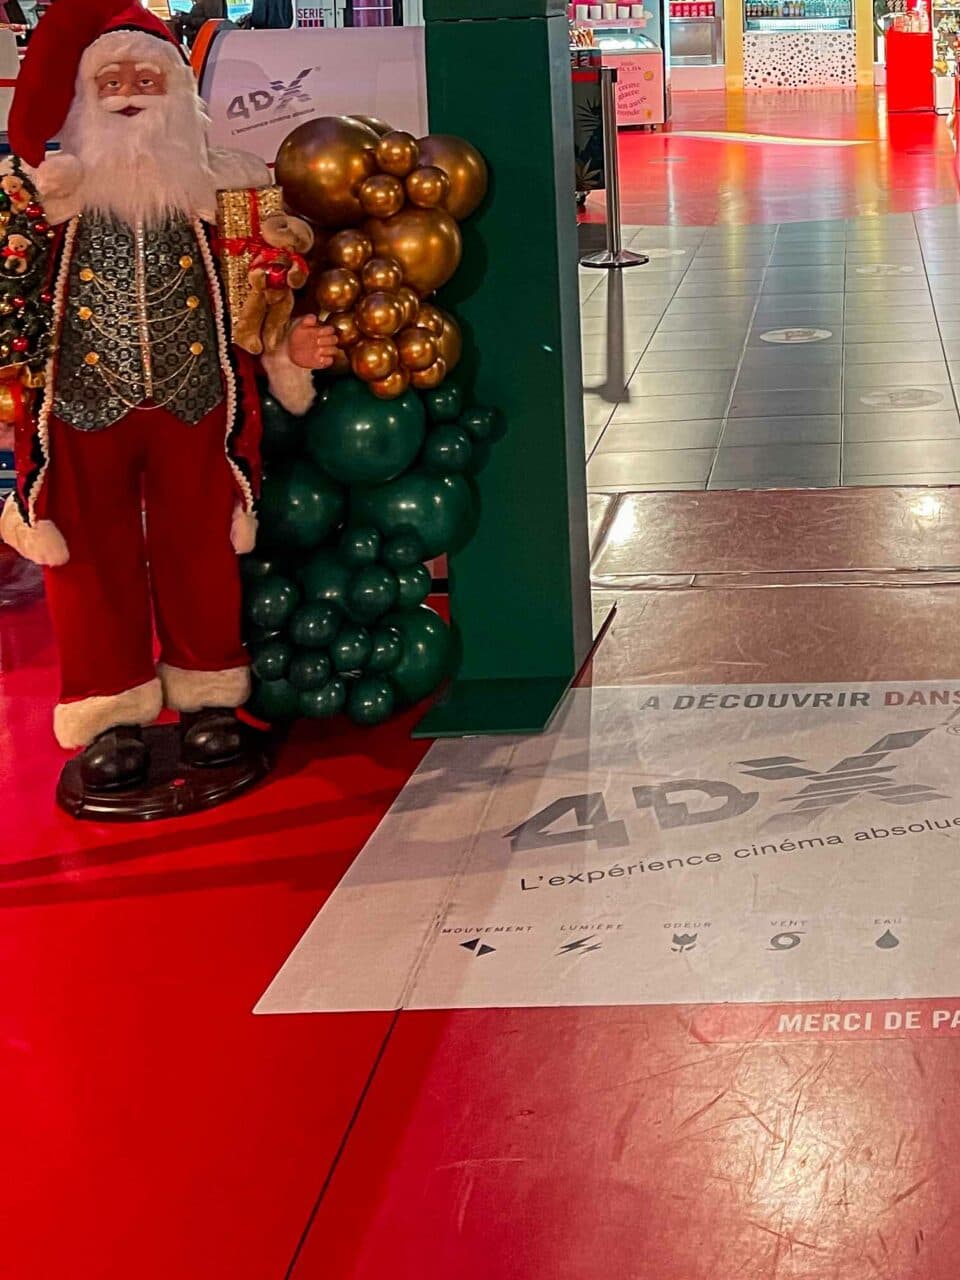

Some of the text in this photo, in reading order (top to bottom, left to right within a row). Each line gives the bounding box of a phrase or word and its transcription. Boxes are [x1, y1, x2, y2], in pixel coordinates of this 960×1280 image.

[297, 7, 325, 19] SERIE
[226, 67, 314, 121] 4DX
[639, 694, 661, 710] A
[673, 691, 870, 710] DÉCOUVRIR
[503, 726, 955, 852] 4DX
[520, 851, 723, 892] L'expérience
[734, 832, 844, 860] cinéma
[442, 925, 534, 934] MOUVEMENT
[778, 1012, 873, 1033] MERCI
[884, 1010, 923, 1030] DE
